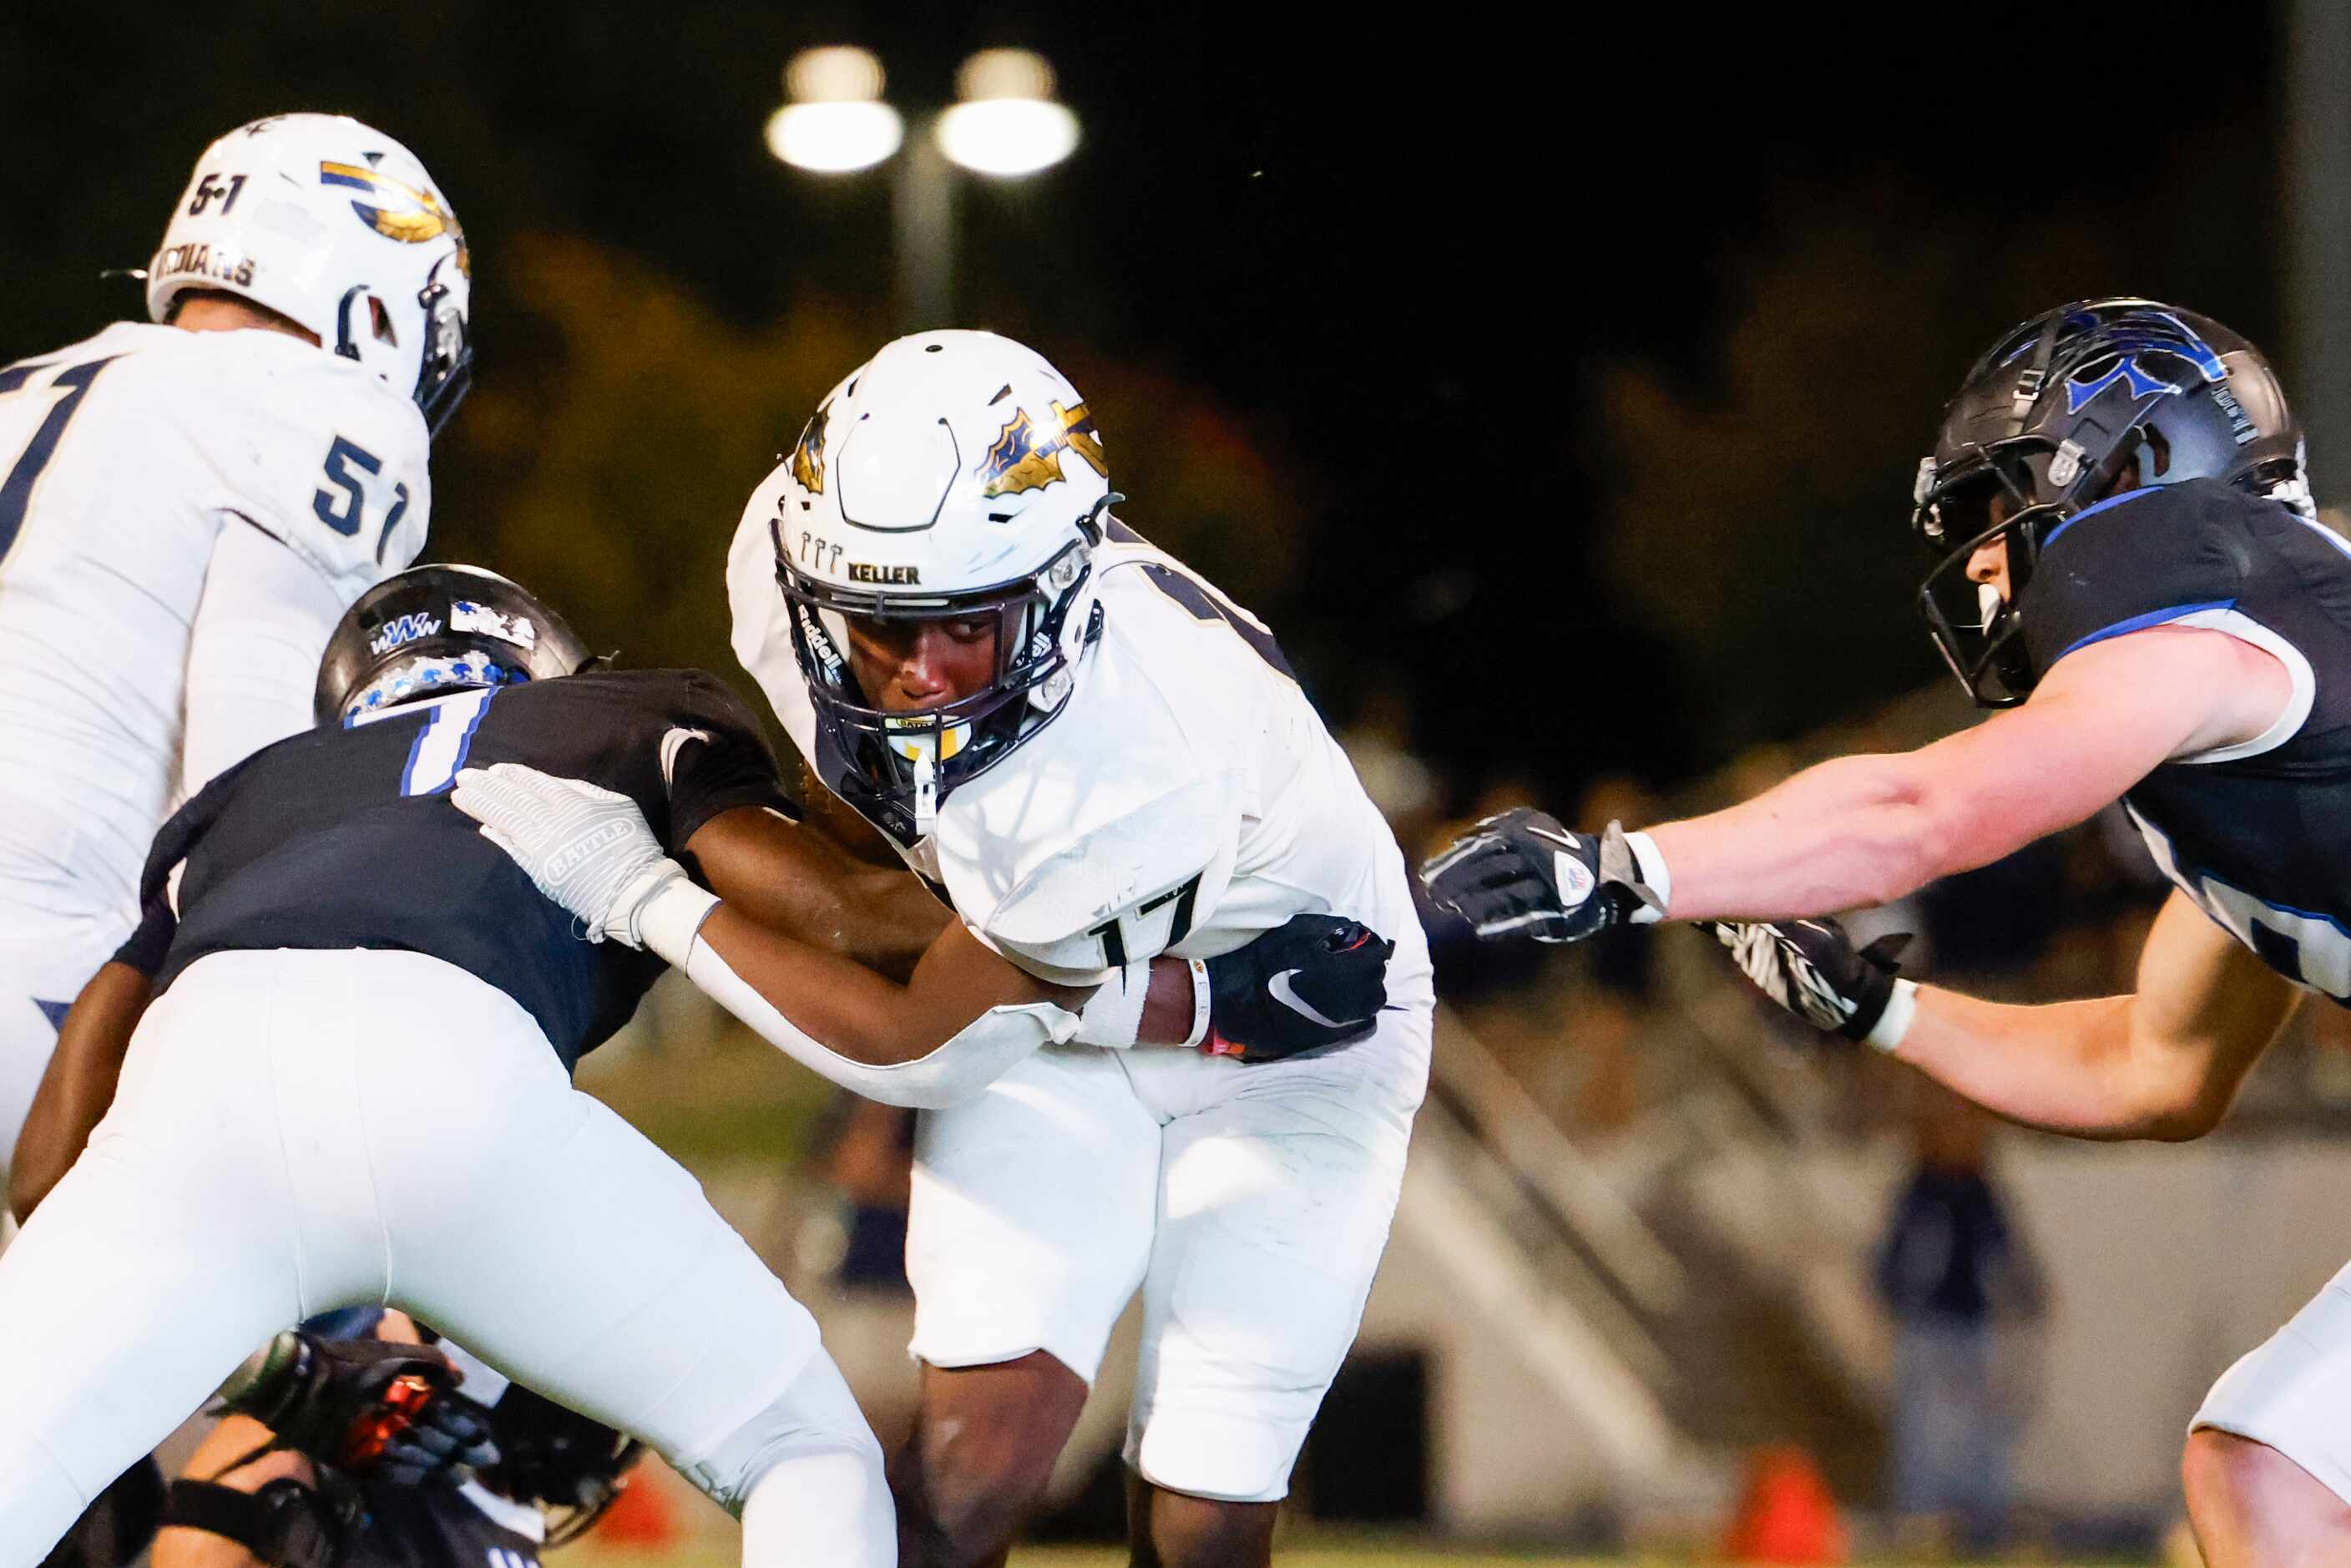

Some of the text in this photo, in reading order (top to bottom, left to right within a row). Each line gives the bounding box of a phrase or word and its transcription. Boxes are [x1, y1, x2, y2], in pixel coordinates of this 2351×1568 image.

[189, 173, 248, 217] 51
[312, 434, 410, 568] 51
[847, 562, 922, 585] KELLER
[343, 685, 503, 797] 7
[549, 820, 631, 878] BATTLE
[1087, 870, 1204, 969] 17
